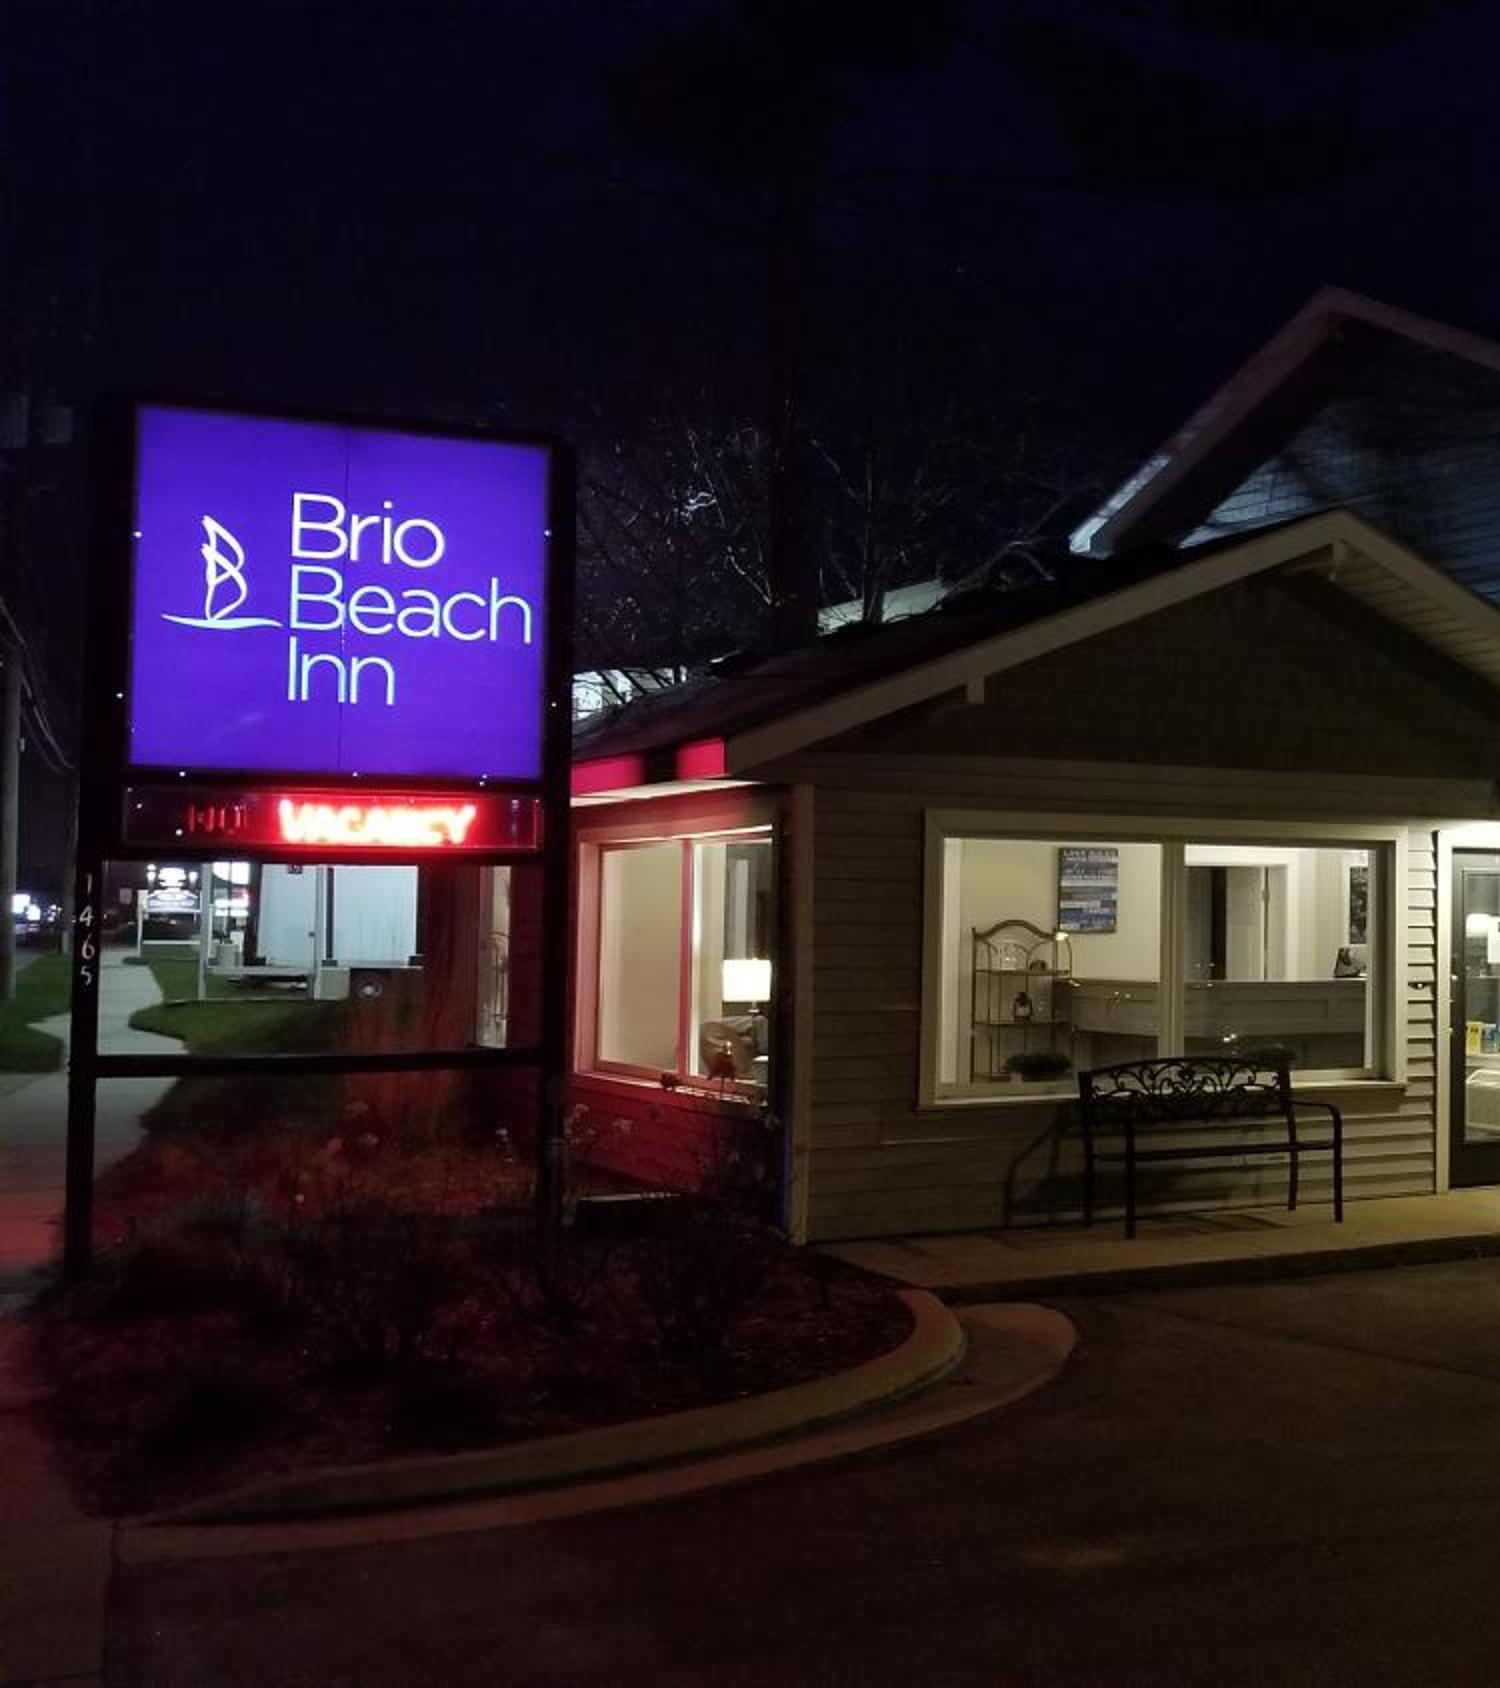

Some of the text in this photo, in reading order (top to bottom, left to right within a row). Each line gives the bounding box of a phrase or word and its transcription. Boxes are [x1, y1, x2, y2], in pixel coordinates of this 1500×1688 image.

[290, 492, 445, 569] Brio
[288, 566, 532, 644] Beach
[287, 637, 396, 706] Inn
[279, 799, 477, 845] VACANCY
[79, 873, 95, 986] 1465
